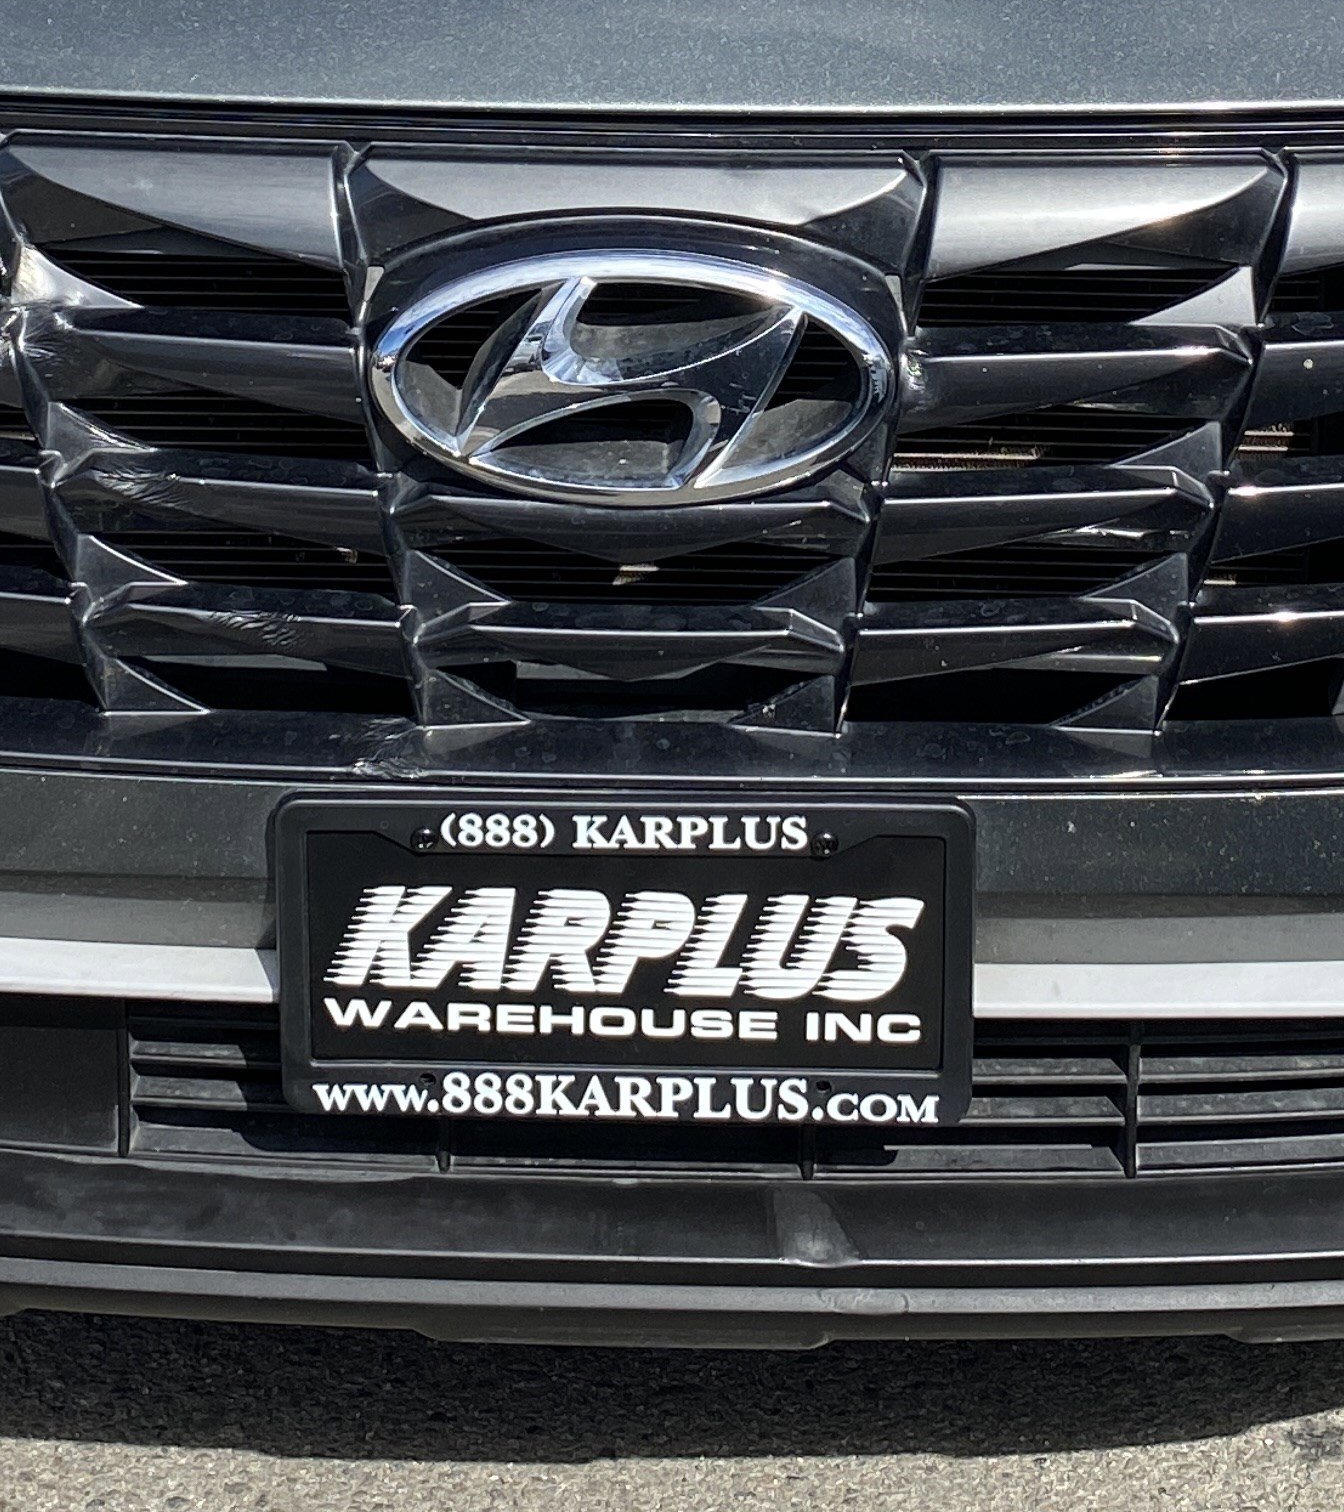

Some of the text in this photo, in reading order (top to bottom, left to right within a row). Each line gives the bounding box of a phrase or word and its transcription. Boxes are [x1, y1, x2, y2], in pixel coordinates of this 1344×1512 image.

[440, 812, 808, 850] (888) KARPLUS
[323, 885, 925, 1001] KARPLUS
[323, 997, 921, 1043] WAREHOUSE INC
